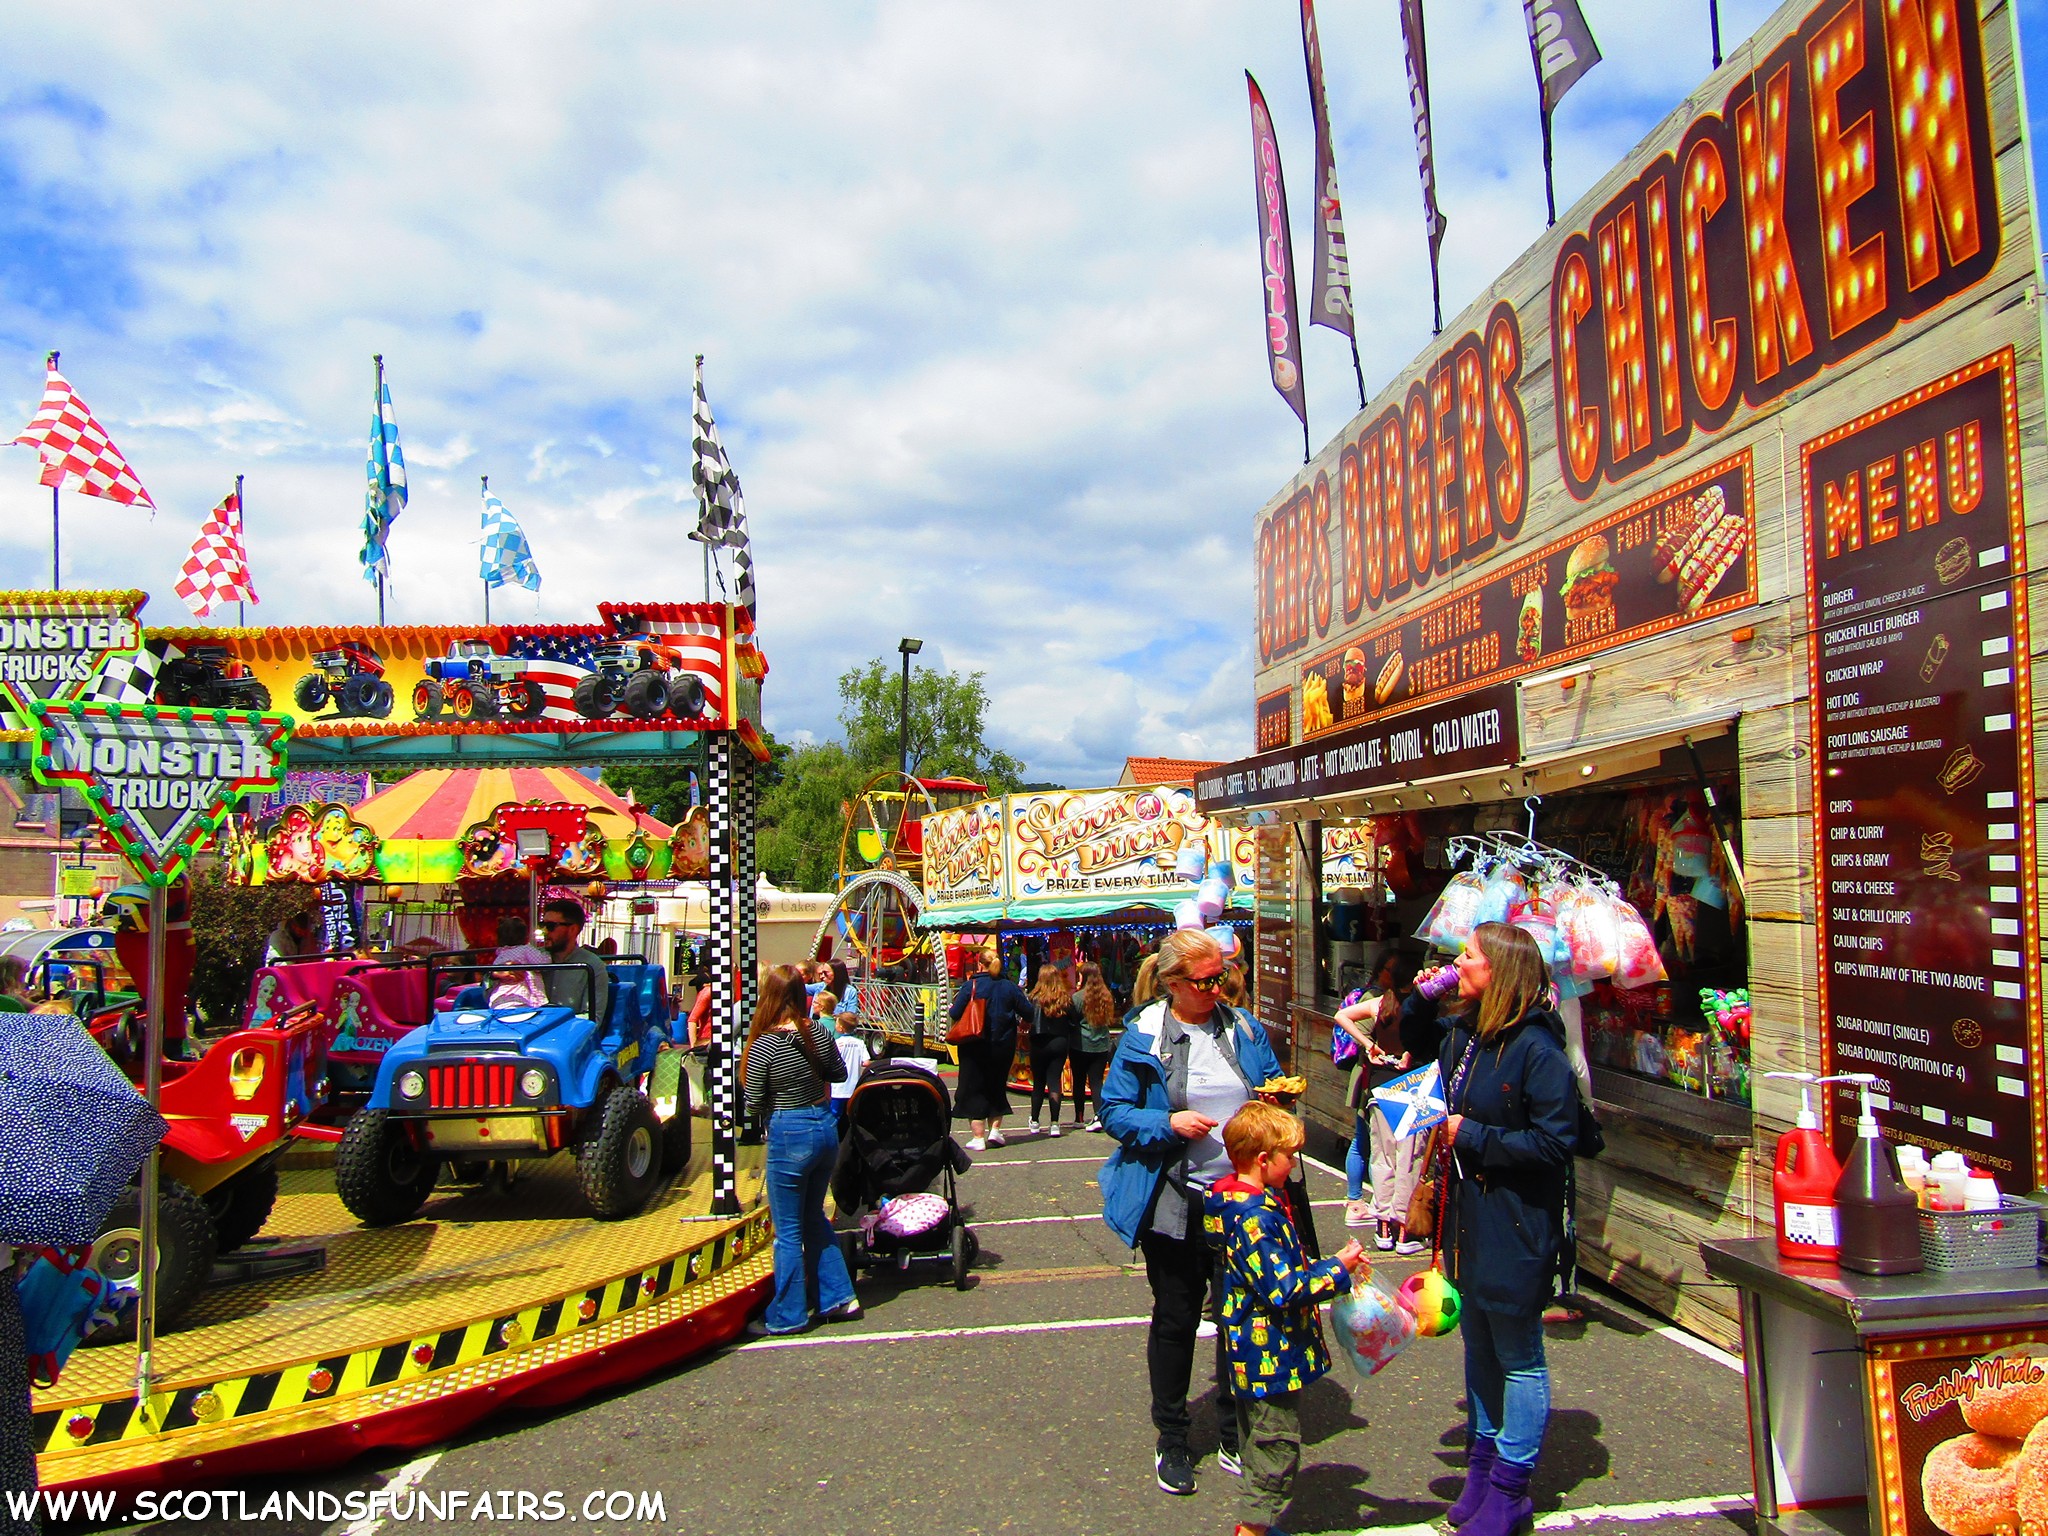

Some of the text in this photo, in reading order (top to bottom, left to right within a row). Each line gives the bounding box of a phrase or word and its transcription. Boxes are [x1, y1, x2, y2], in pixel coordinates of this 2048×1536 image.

[1261, 478, 1331, 658] CHIPS
[1343, 316, 1524, 614] BURGERS
[1558, 0, 1981, 483] CHICKEN
[1823, 419, 1983, 560] MENU
[1617, 494, 1696, 554] FOOT LONG
[1510, 563, 1548, 599] WRAPS
[1908, 584, 1926, 597] SAUCE
[1823, 588, 1854, 608] BURGER
[0, 618, 137, 650] ONSTER
[1420, 592, 1482, 651] FUNTIME
[1564, 604, 1618, 646] CHICKEN
[1824, 610, 1920, 645] CHICKEN FILLET BURGER
[1375, 634, 1390, 658] HOT
[1866, 636, 1882, 648] SALAD
[1888, 632, 1903, 643] MAYO
[0, 654, 94, 681] TRUCKS
[1408, 630, 1501, 696] STREET FOOD
[1826, 660, 1884, 684] CHICKEN WRAP
[1826, 692, 1859, 710] HOT DOG
[1886, 700, 1909, 713] KETCHUP
[1915, 695, 1940, 708] MUSTARD
[1260, 708, 1287, 749] MENU
[1828, 725, 1909, 749] FOOT LONG SAUSAGE
[50, 736, 273, 778] MONSTER
[1208, 777, 1224, 799] DRINKS
[1226, 772, 1244, 796] COFFEE
[1247, 770, 1257, 792] TEA
[1261, 760, 1295, 790] CAPPUCCINO
[1300, 754, 1319, 783] LATTE
[1324, 750, 1338, 778] HOT
[1339, 737, 1382, 776] CHOCOLATE
[1389, 728, 1423, 764] BOVRIL
[1432, 718, 1460, 756] COLD
[1460, 708, 1500, 750] WATER
[1886, 742, 1910, 754] KETCHUP
[1916, 738, 1942, 750] MUSTARD
[106, 778, 216, 810] TRUCK
[1829, 800, 1853, 814] CHIPS
[1051, 796, 1129, 853] HOOK
[1830, 826, 1884, 840] CHIP & CURRY
[1090, 820, 1176, 868] DUCK
[1831, 854, 1890, 867] CHIPS & GRAVY
[1046, 872, 1186, 890] PRIZE EVERY TIME
[1832, 881, 1895, 895] CHIPS & CHEESE
[781, 898, 817, 913] Cakes
[1832, 908, 1911, 924] SALT & CHILLI CHIPS
[1833, 934, 1883, 951] CAJUN CHIPS
[1834, 962, 1985, 991] CHIPS WITH ANY OF THE TWO ABOVE
[1836, 1015, 1930, 1045] SUGAR DONUT (SINGLE)
[1837, 1042, 1966, 1083] SUGAR DONUTS (PORTION OF 4)
[1839, 1089, 1854, 1100] LARGE
[1892, 1101, 1909, 1113] SMALL
[1910, 1105, 1921, 1116] TUB
[1952, 1115, 1964, 1127] BAG
[1988, 1155, 2012, 1171] PRICES
[1902, 1356, 2044, 1420] Freshly Made
